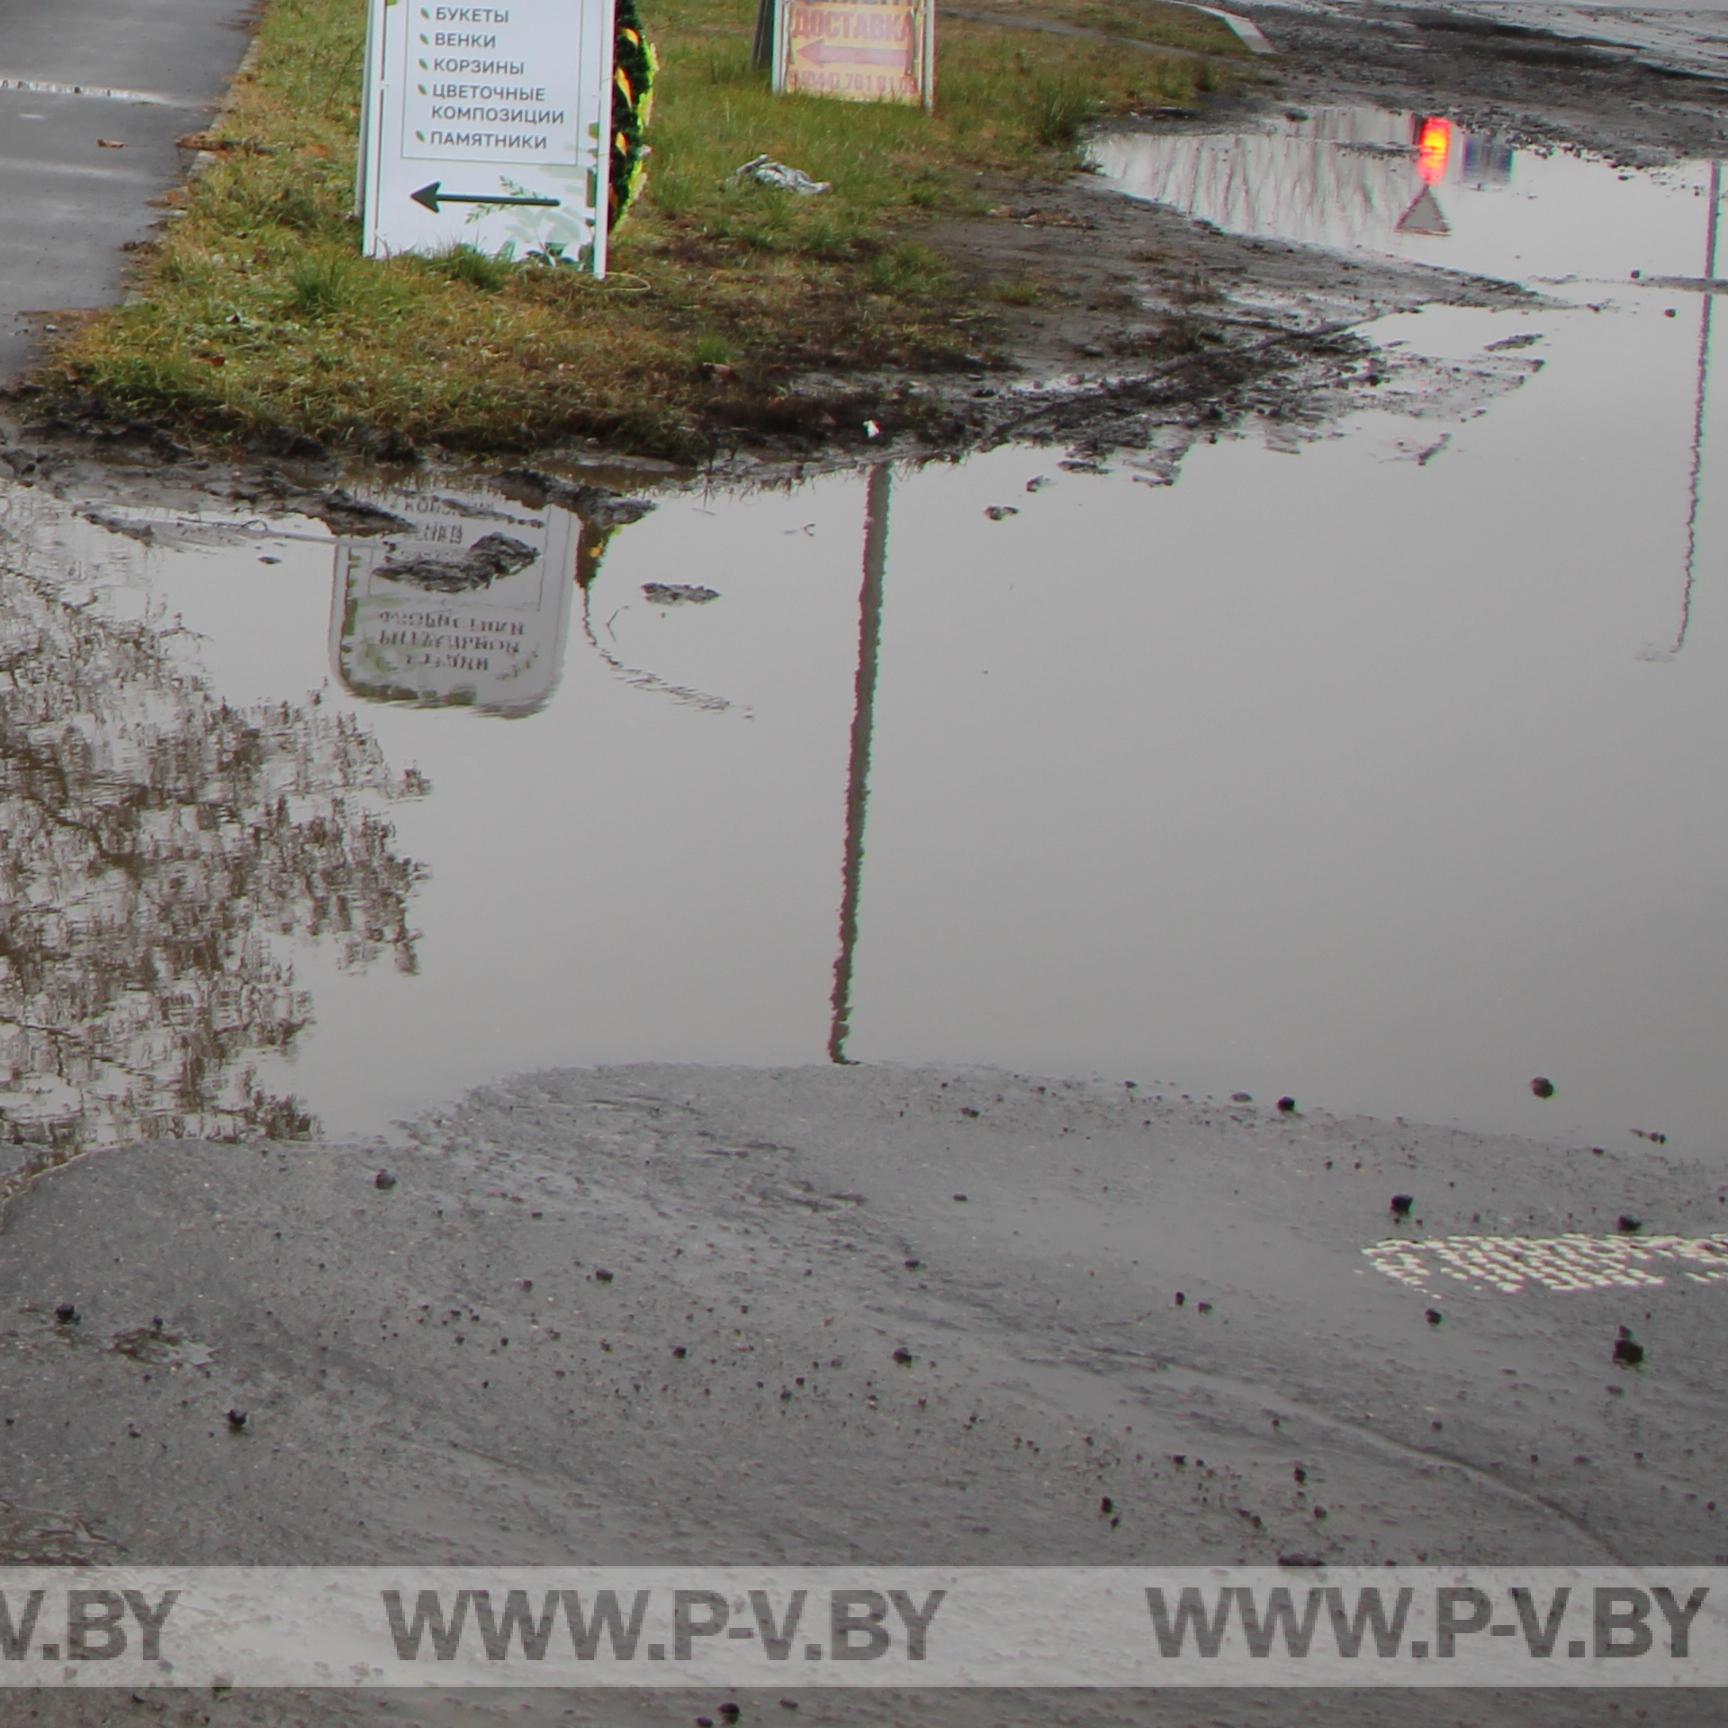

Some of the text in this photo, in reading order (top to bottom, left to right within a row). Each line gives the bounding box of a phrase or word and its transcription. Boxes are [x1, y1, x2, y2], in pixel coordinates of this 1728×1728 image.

[435, 7, 509, 23] БУКЕТЫ
[793, 8, 913, 41] ДОСТАВКА
[434, 32, 496, 48] ВЕНКИ
[433, 58, 524, 75] КОРЗИНЫ
[432, 83, 546, 102] ЦВЕТОЧНЫЕ
[431, 106, 564, 125] КОМПОЗИЦИИ
[430, 131, 547, 150] ПАМЯТНИКИ
